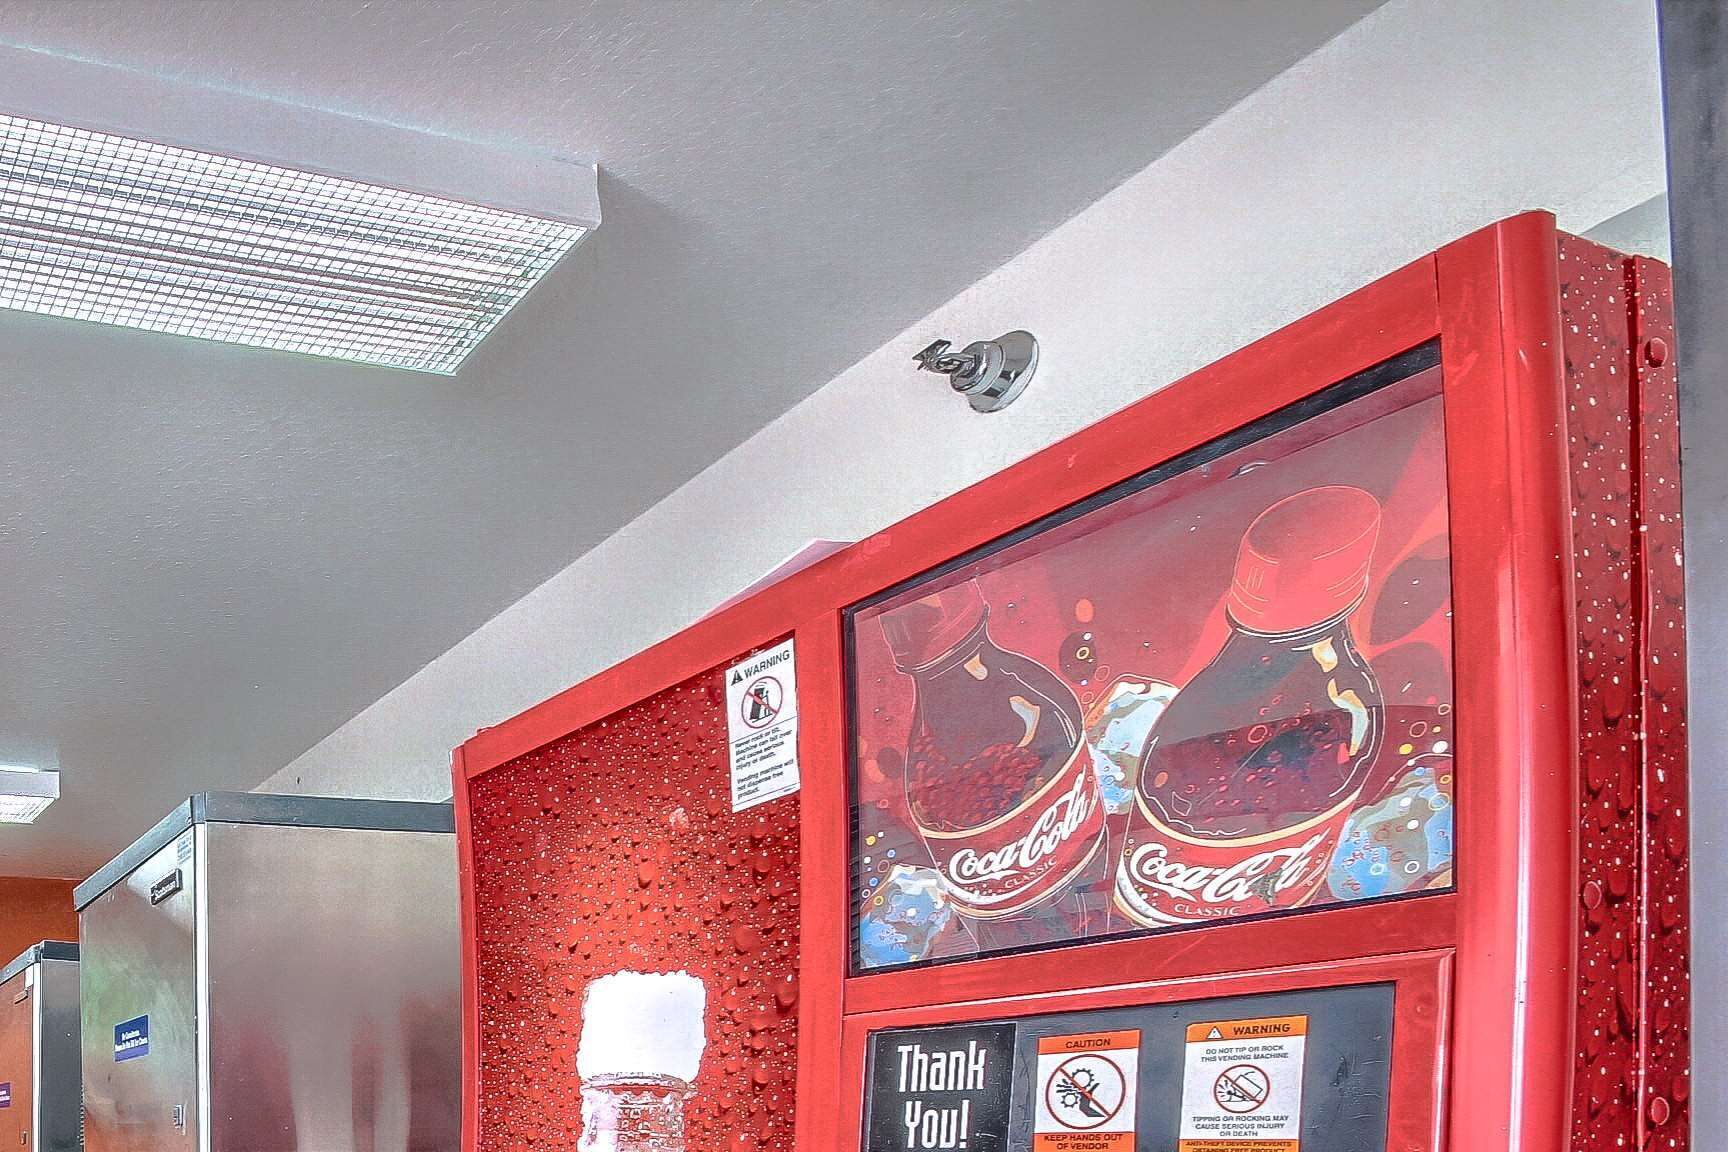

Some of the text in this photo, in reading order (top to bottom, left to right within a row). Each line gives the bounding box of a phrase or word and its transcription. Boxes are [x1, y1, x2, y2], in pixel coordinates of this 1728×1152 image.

[743, 650, 790, 680] WARNING
[949, 766, 1090, 885] Coca-Cola
[1004, 855, 1057, 889] CLASSIC
[1173, 903, 1242, 917] CLASSIC
[1233, 1023, 1291, 1036] WARNING
[1065, 1038, 1111, 1049] CAUTION
[896, 1040, 988, 1093] Thank
[1218, 1054, 1252, 1062] VENDING
[1253, 1052, 1289, 1060] MACHINE
[904, 1099, 971, 1150] You!
[1056, 1142, 1110, 1151] OF VENDOR
